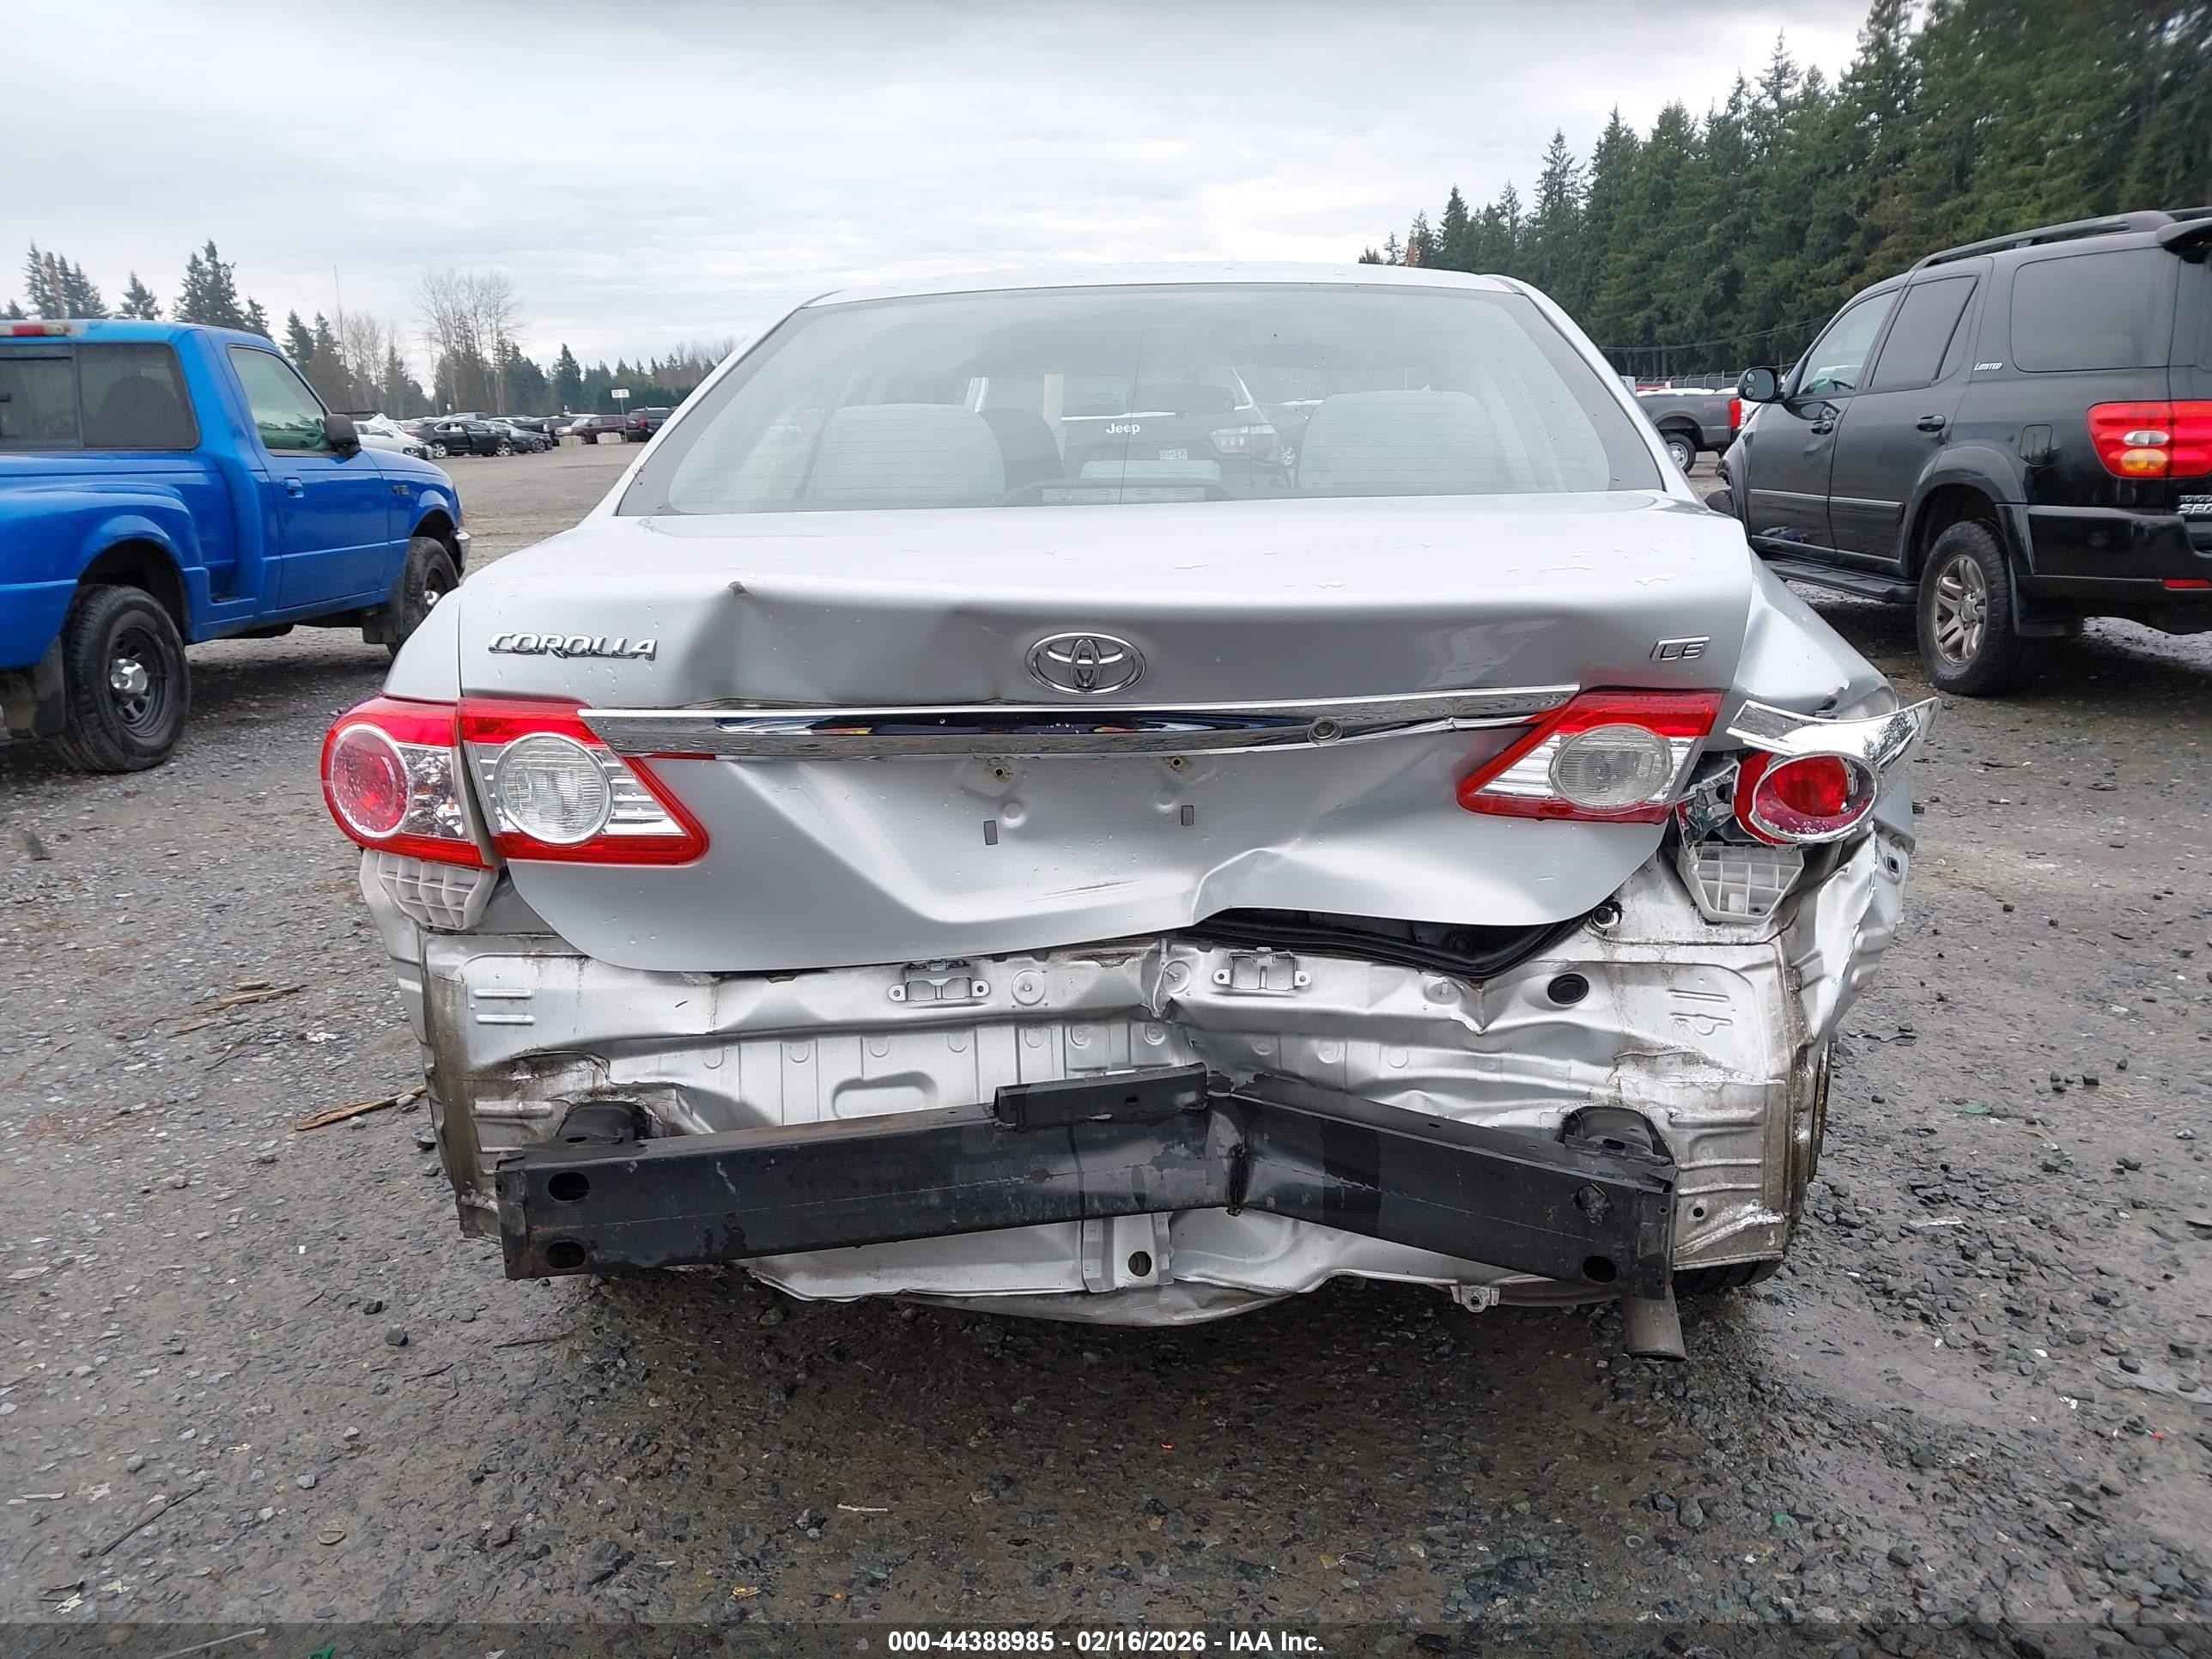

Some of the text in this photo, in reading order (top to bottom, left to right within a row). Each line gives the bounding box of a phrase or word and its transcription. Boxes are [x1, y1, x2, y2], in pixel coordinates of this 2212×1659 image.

[1973, 362, 2003, 371] LIMITED
[1105, 422, 1140, 434] Jeep
[488, 632, 658, 660] COROLLA
[1653, 637, 1709, 661] LE
